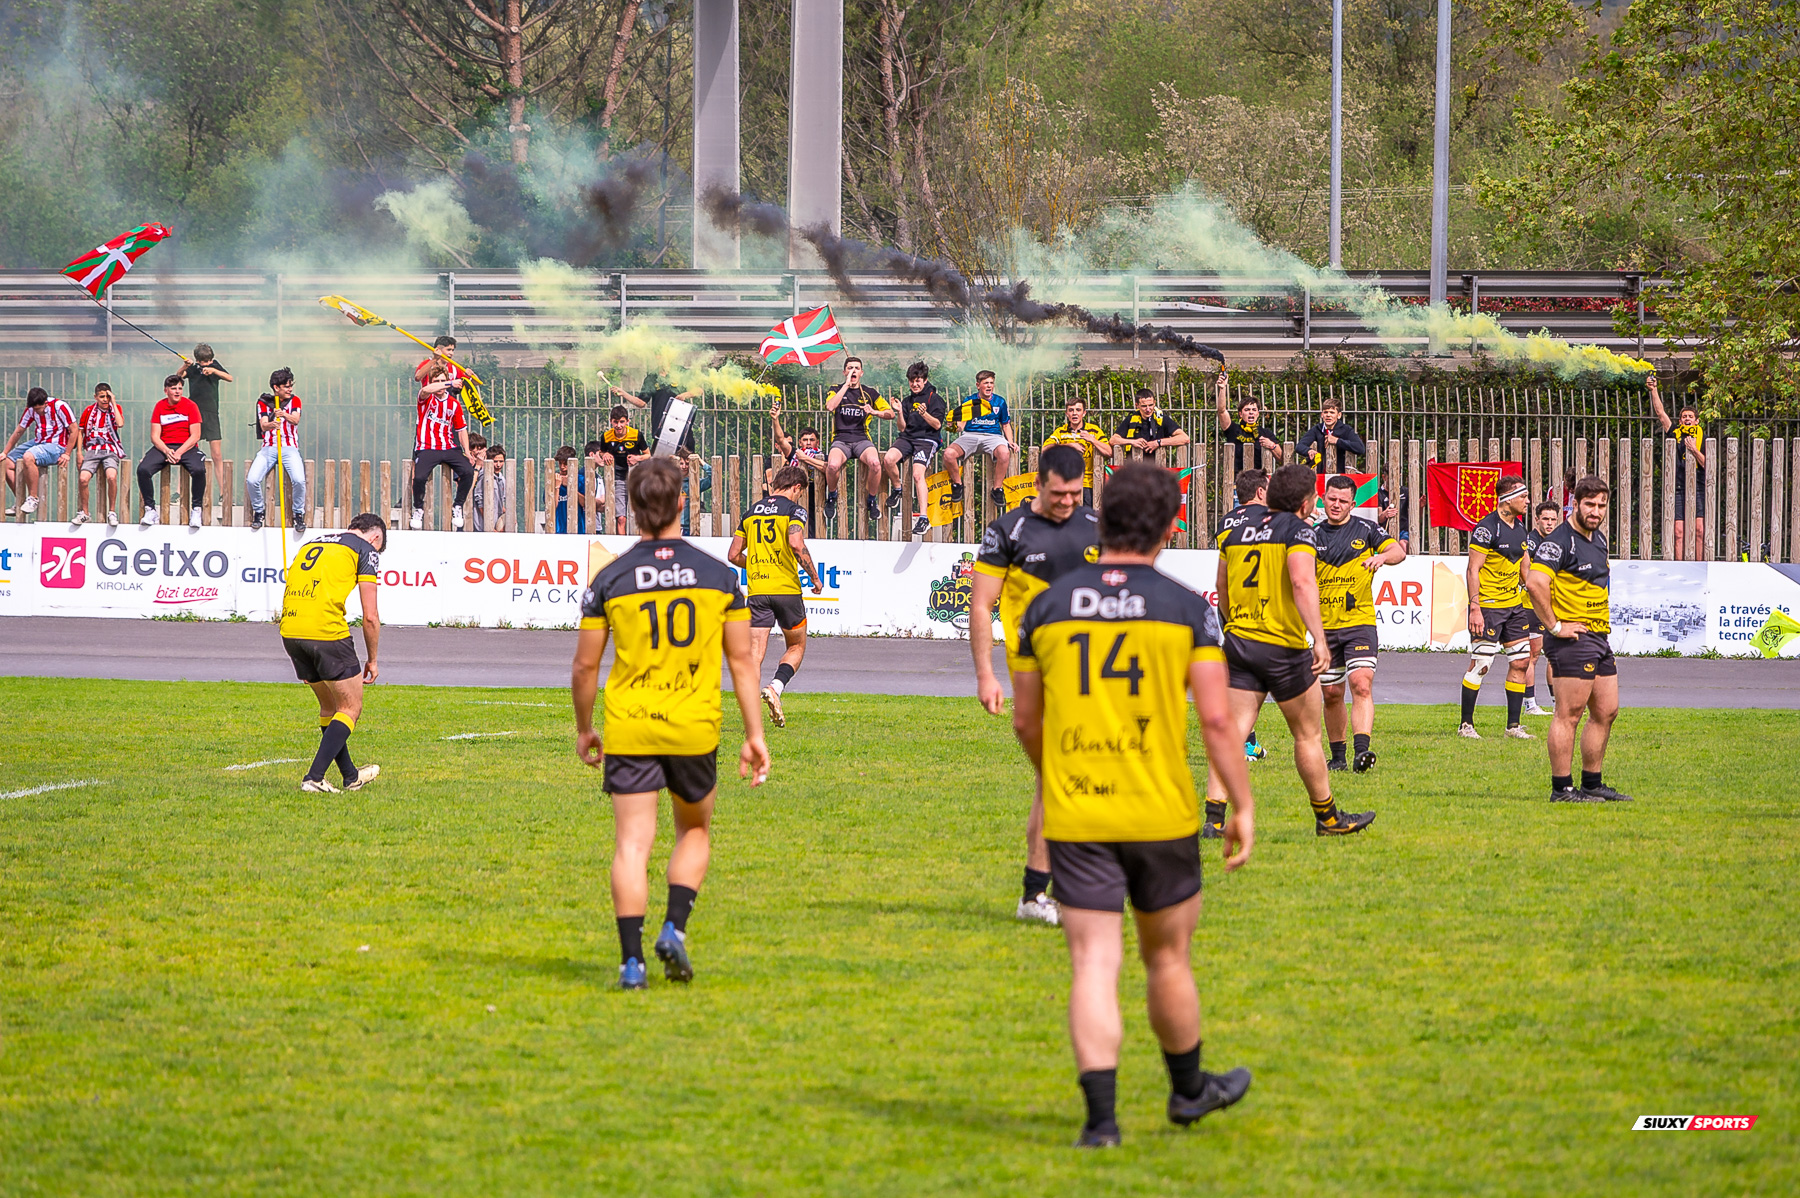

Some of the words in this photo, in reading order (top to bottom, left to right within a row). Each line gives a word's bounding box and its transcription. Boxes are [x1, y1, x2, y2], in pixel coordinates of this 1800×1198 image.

[754, 503, 778, 514] Deia
[753, 518, 776, 544] 13
[96, 538, 229, 578] Getxo
[301, 546, 324, 571] 9
[463, 557, 579, 586] SOLAR
[635, 563, 697, 590] Deia
[1242, 550, 1261, 588] 2
[96, 582, 143, 591] KIROLAK
[156, 585, 180, 599] bizi
[183, 586, 219, 598] ezazu
[512, 588, 578, 604] PACK
[804, 607, 840, 615] TIONS
[1070, 587, 1147, 619] Deia
[1719, 605, 1726, 614] a
[1730, 603, 1771, 615] través
[640, 597, 696, 650] 10
[1375, 610, 1422, 625] ACK
[1719, 616, 1730, 627] la
[1734, 616, 1768, 628] difer
[1719, 630, 1757, 641] tecno
[1069, 632, 1144, 695] 14
